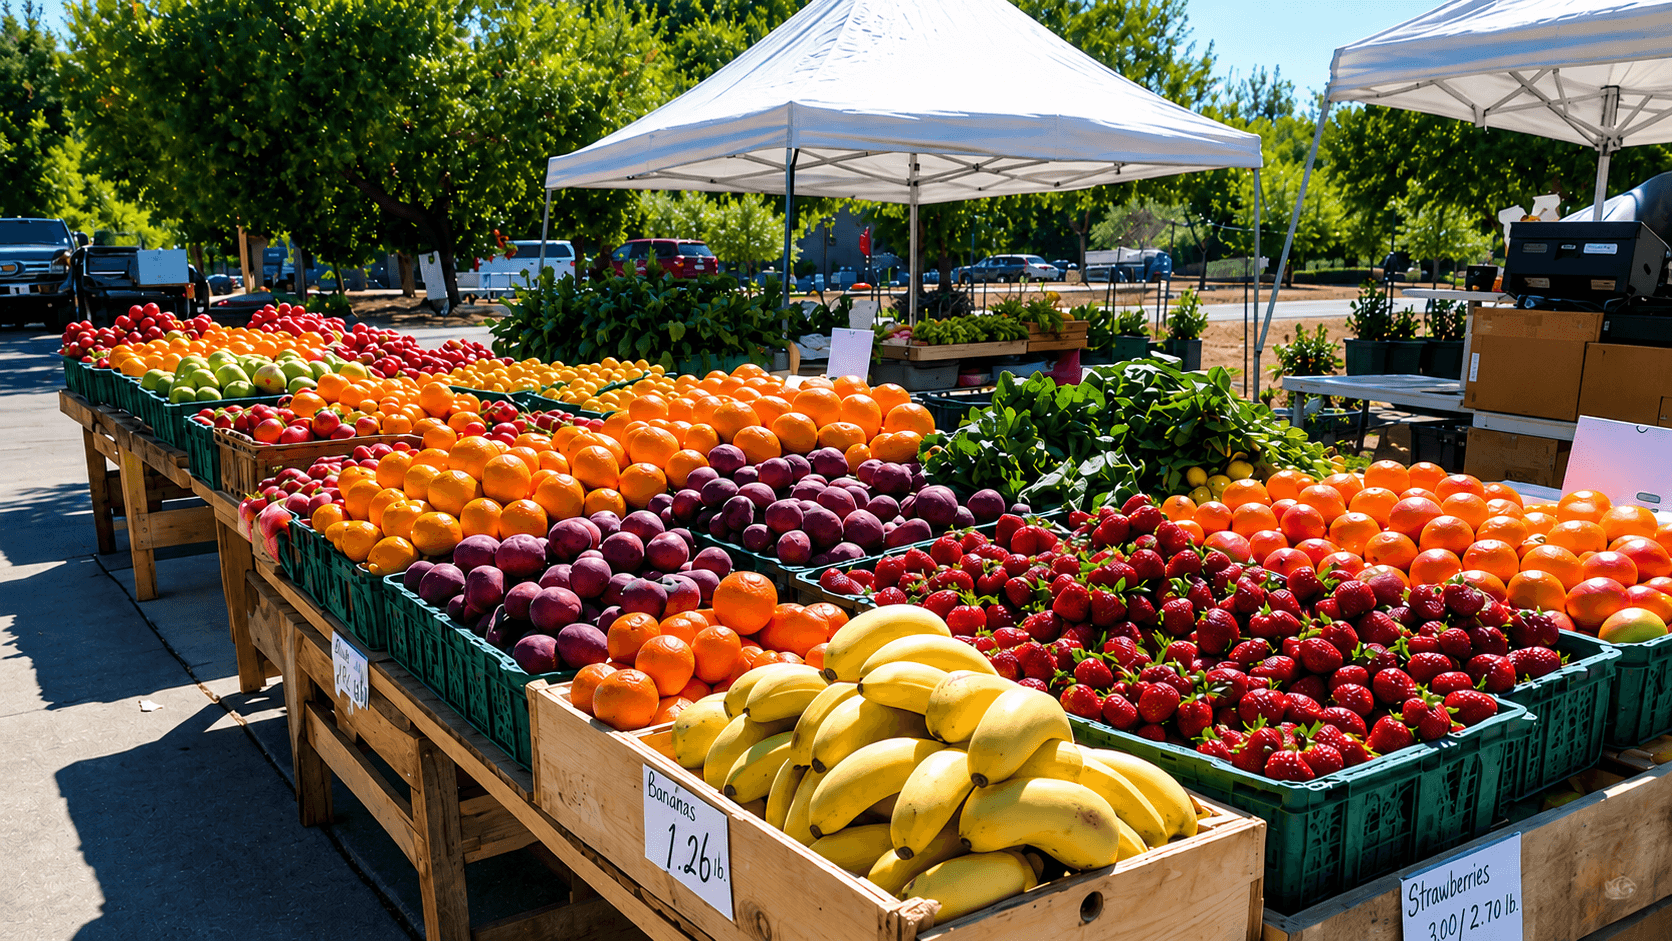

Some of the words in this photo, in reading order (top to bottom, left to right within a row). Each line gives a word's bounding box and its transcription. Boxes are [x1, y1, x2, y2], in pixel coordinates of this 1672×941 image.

[648, 770, 696, 822] Bananas
[1408, 863, 1490, 918] Strawberries
[1505, 893, 1519, 916] lb.
